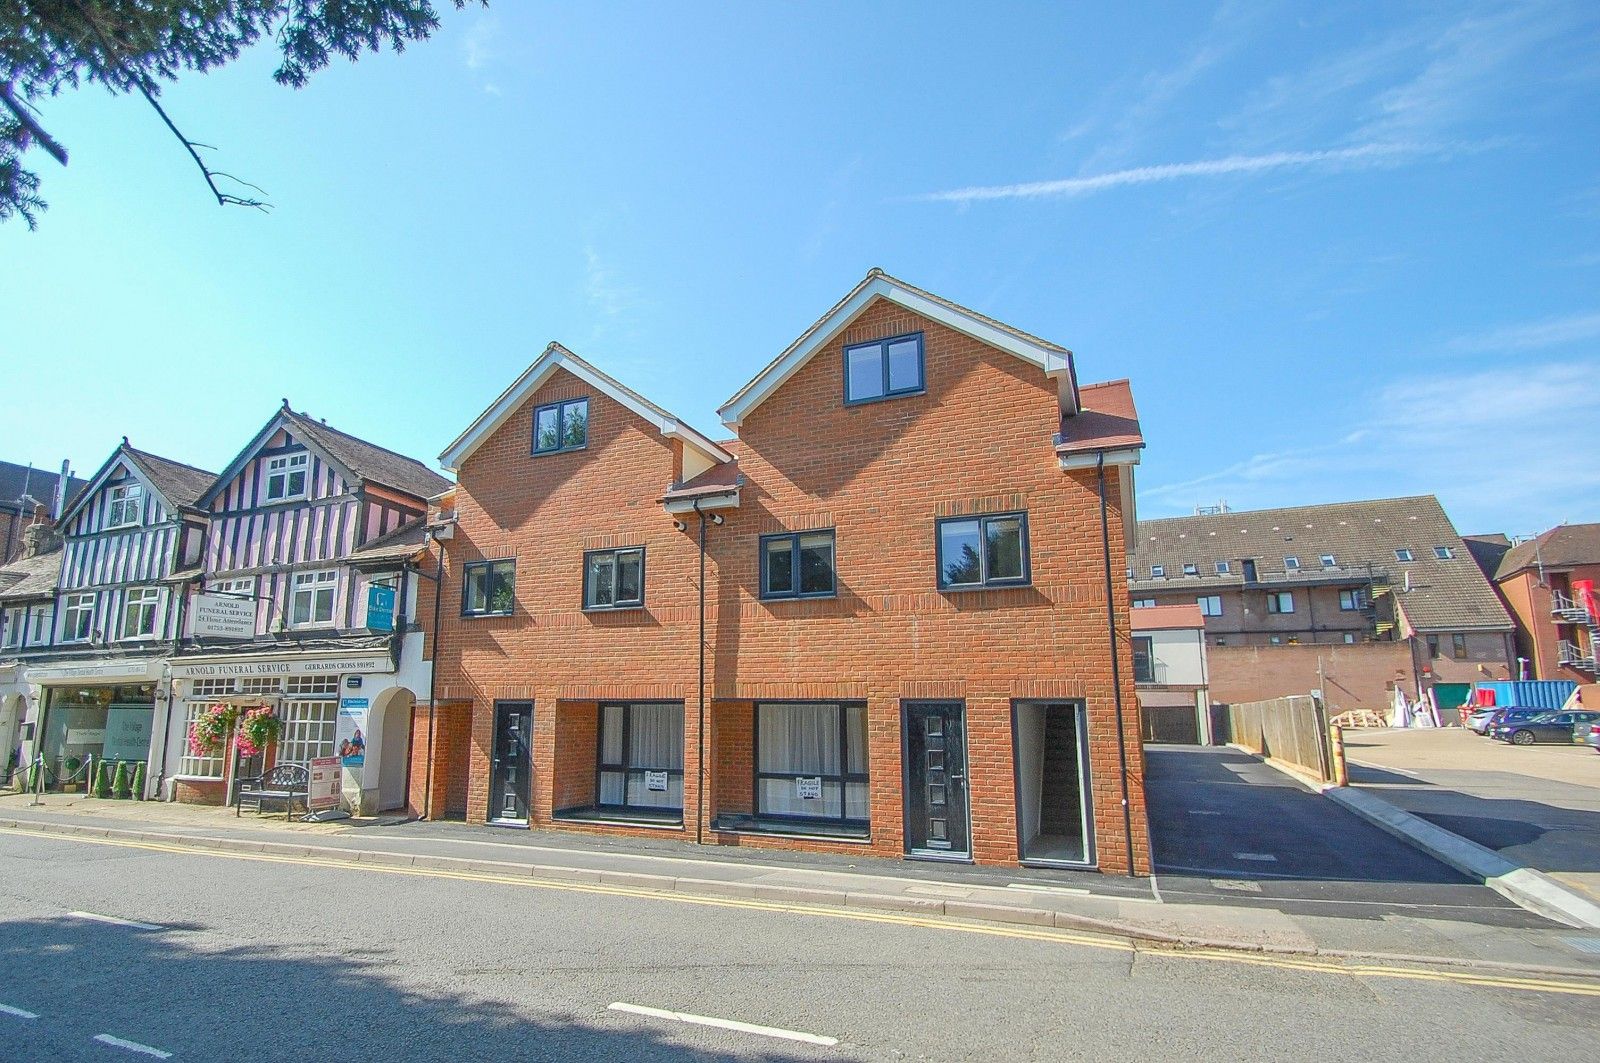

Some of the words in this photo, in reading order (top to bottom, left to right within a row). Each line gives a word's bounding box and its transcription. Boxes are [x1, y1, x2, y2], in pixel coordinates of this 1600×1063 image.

[199, 607, 227, 615] FUNERAL
[186, 666, 215, 675] ARNOLD
[219, 665, 254, 674] FUNERAL
[257, 663, 291, 673] SERVICE
